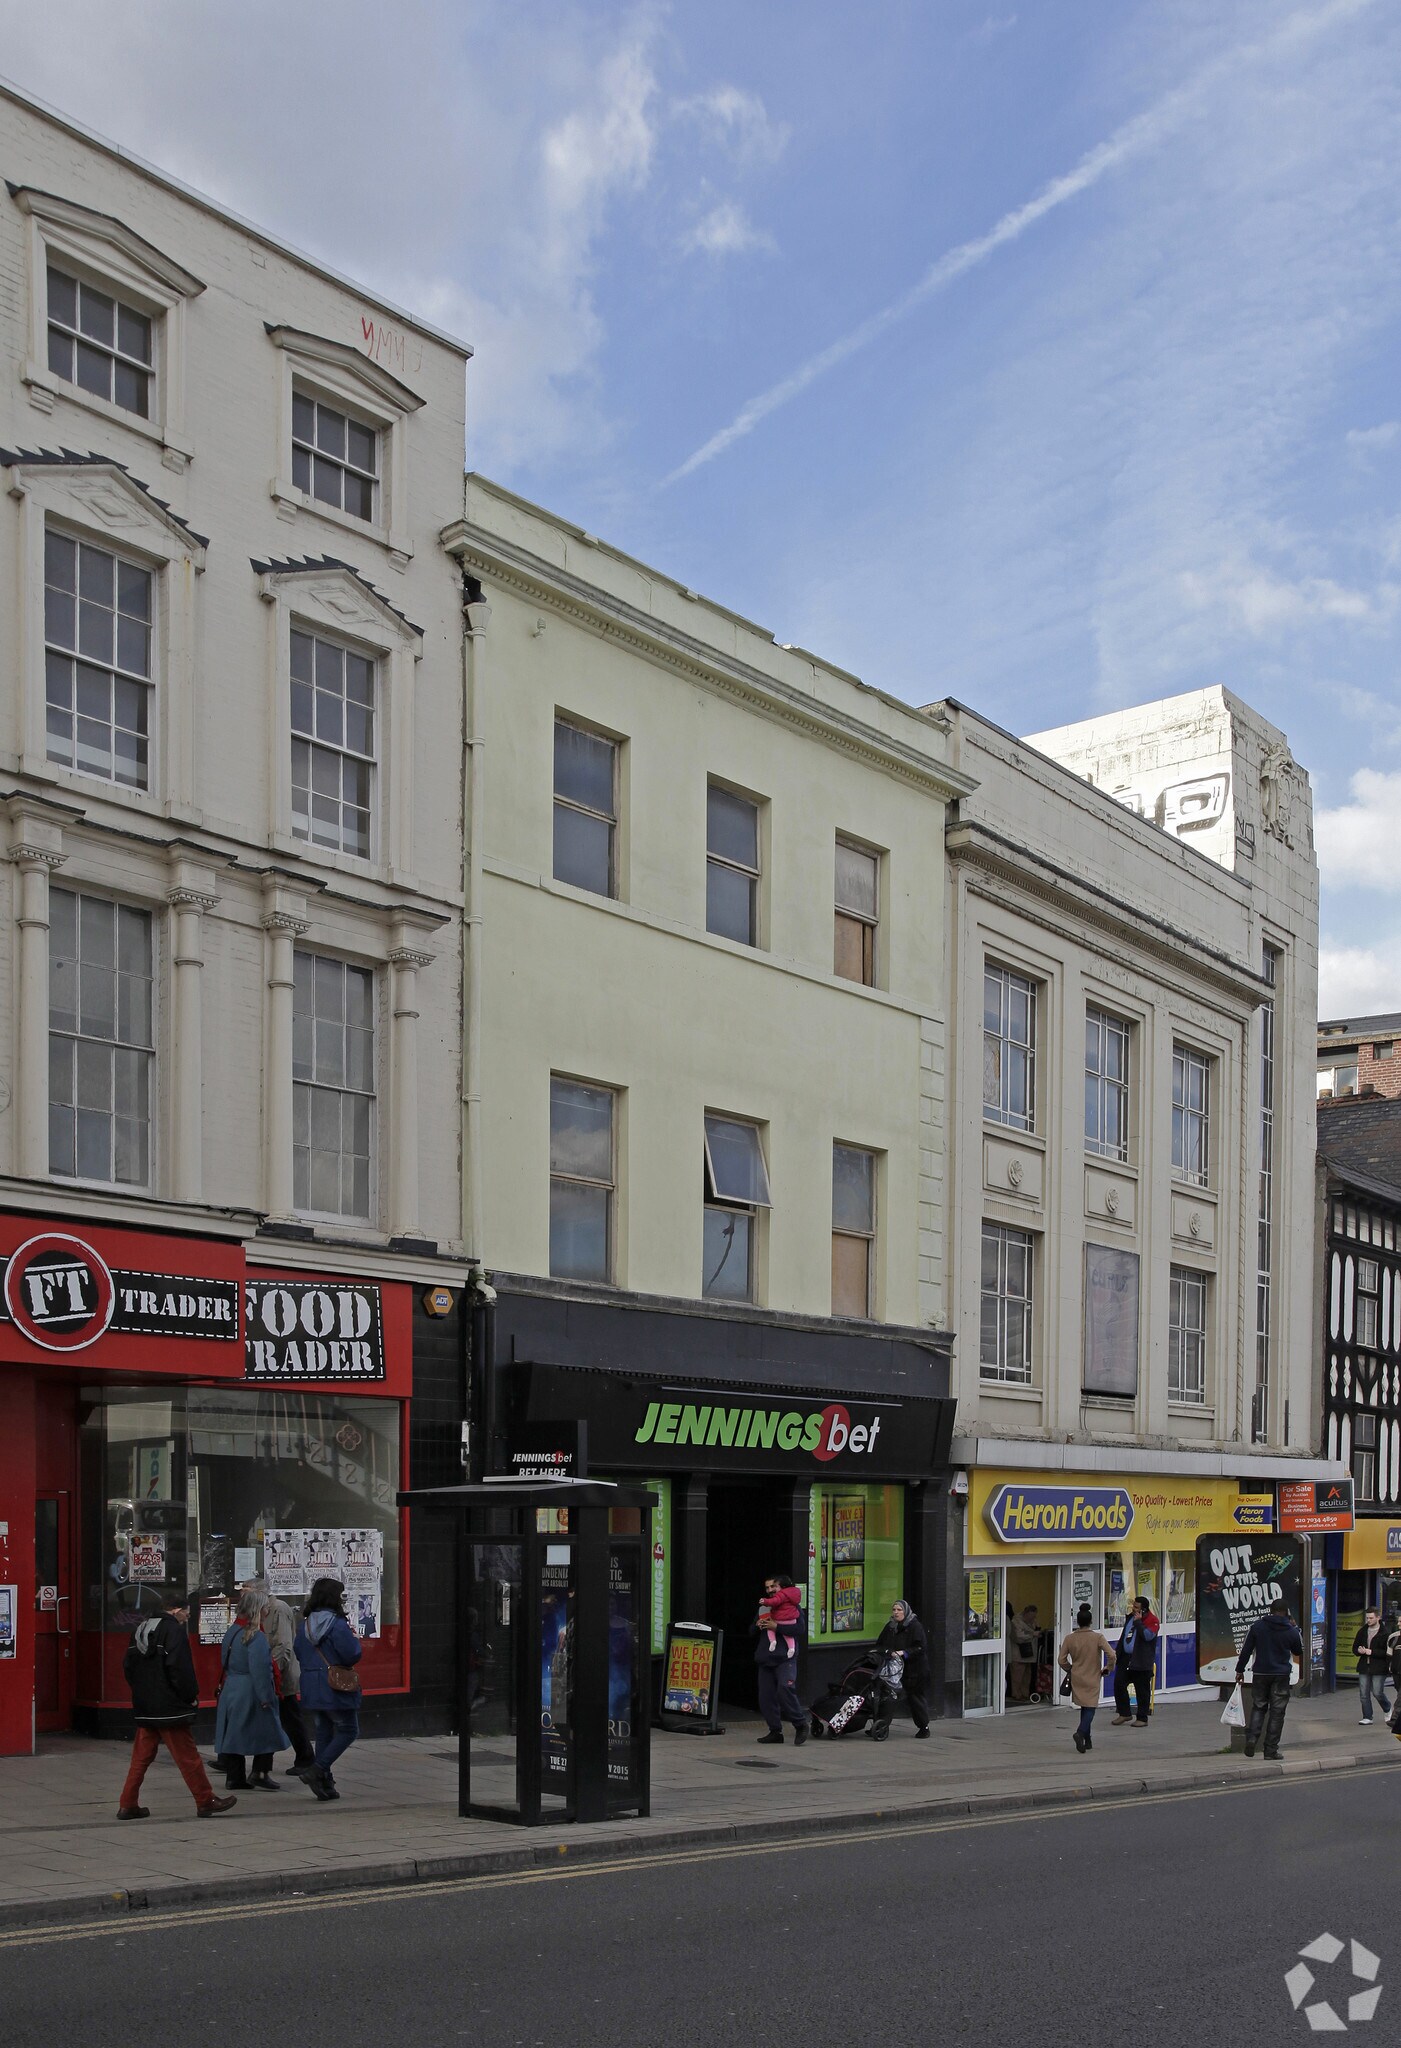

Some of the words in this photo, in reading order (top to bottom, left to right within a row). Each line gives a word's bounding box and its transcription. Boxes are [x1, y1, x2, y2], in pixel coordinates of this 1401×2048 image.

[25, 1269, 90, 1317] FT
[120, 1288, 232, 1321] TRADER
[519, 1468, 537, 1477] BET
[540, 1468, 567, 1477] HERE
[1295, 1485, 1312, 1493] Sale
[1132, 1494, 1144, 1508] Top
[1145, 1494, 1168, 1509] Quality
[1173, 1496, 1194, 1507] Lowest
[1195, 1496, 1213, 1507] Prices
[1319, 1498, 1349, 1507] acuitus
[836, 1508, 853, 1521] ONLY
[1003, 1494, 1069, 1530] Heron
[1070, 1494, 1127, 1530] Foods
[1240, 1507, 1264, 1515] Heron
[1145, 1513, 1161, 1535] Right
[1162, 1519, 1169, 1534] up
[1170, 1518, 1183, 1534] your
[1239, 1515, 1263, 1523] Foods
[837, 1520, 863, 1539] HERE
[1209, 1544, 1253, 1577] OUT
[610, 1569, 622, 1581] TIC
[1223, 1574, 1235, 1588] OF
[1236, 1571, 1259, 1586] THIS
[614, 1582, 632, 1590] SHOW!
[835, 1578, 852, 1591] ONLY
[836, 1588, 863, 1608] HERE
[1222, 1581, 1283, 1610] WORLD
[1229, 1609, 1258, 1619] Sheffield's
[671, 1646, 689, 1660] WE
[692, 1647, 712, 1661] PAY
[670, 1660, 710, 1681] £680
[550, 1755, 561, 1765] TUE
[561, 1757, 568, 1767] 27
[613, 1765, 629, 1775] 2015
